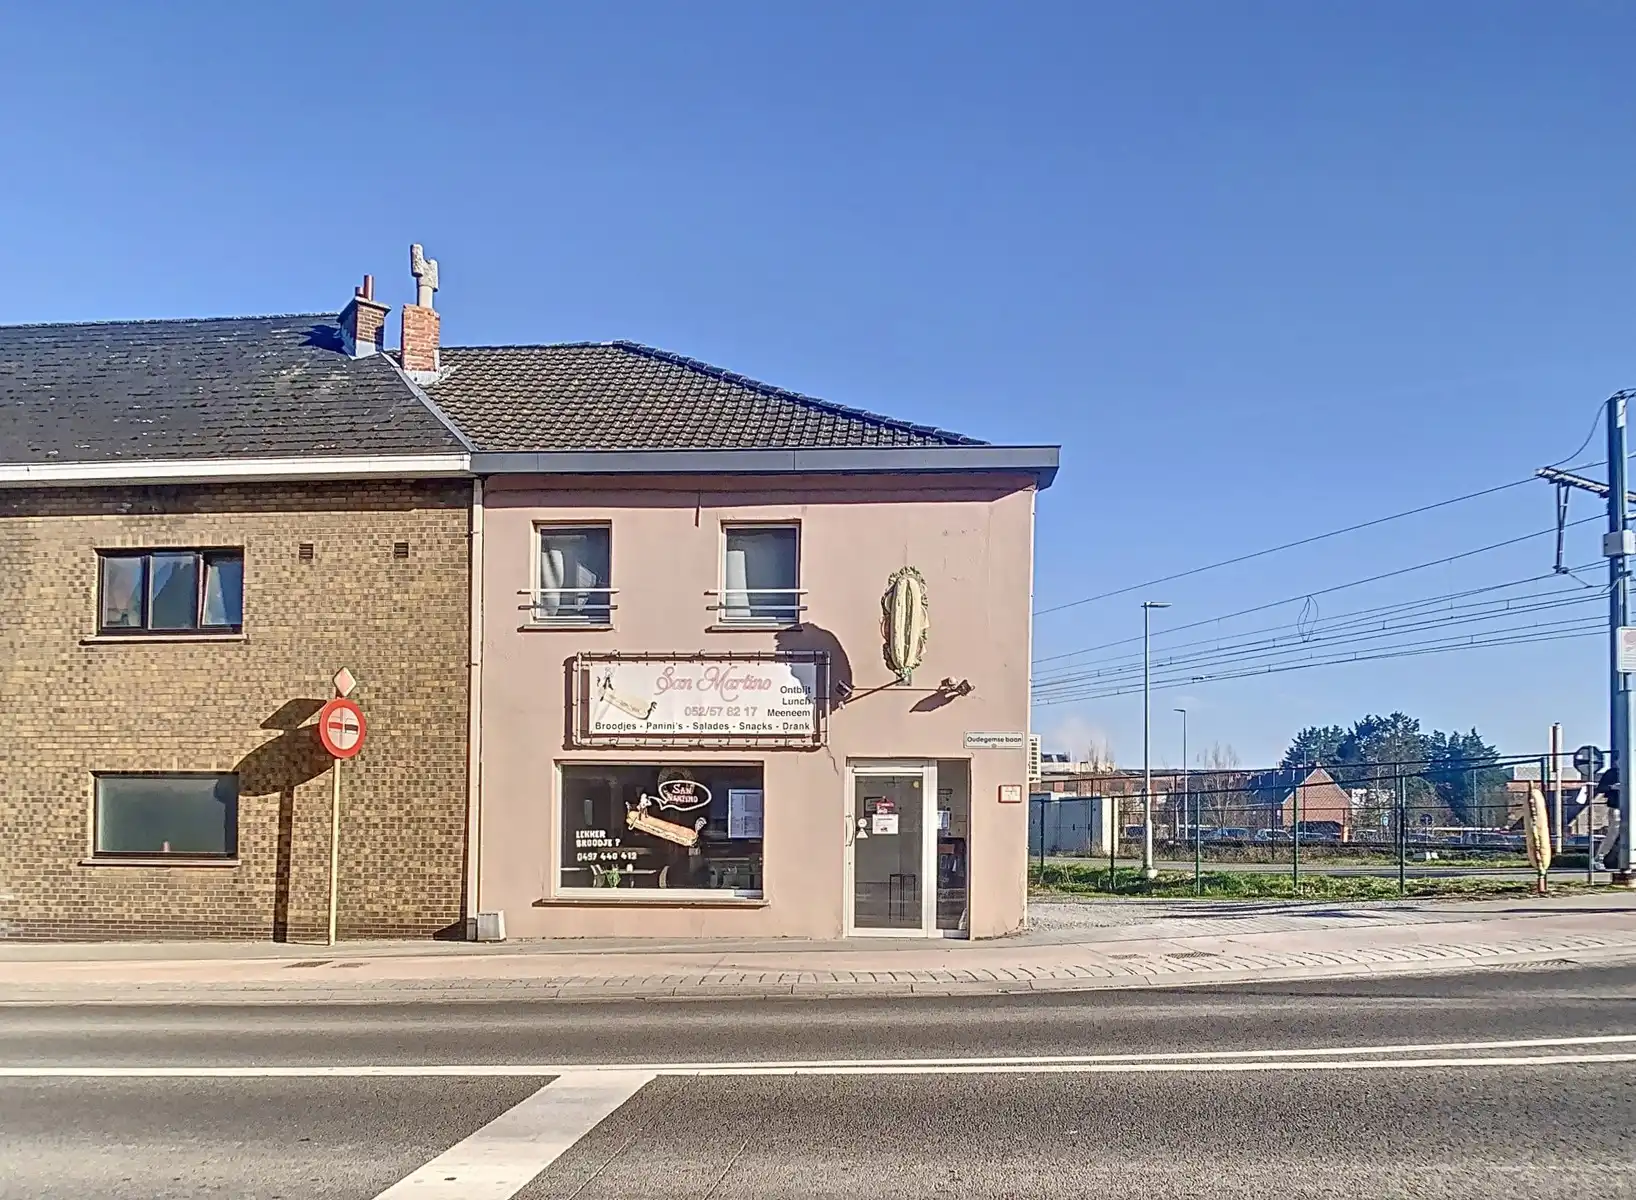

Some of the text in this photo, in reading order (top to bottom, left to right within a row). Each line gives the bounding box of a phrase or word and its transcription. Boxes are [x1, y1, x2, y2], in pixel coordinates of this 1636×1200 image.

[654, 666, 772, 702] San Martino
[782, 697, 811, 705] Lunch
[684, 706, 723, 717] 052/57
[744, 706, 758, 717] 17
[767, 708, 811, 717] Meeneem
[595, 721, 637, 732] Broodjes
[646, 721, 684, 731] Panini's
[692, 721, 730, 731] Salades
[739, 721, 773, 731] Snacks
[782, 721, 810, 731] Drank
[575, 830, 606, 838] LEKKER
[575, 839, 613, 848] BROODJE
[576, 851, 637, 862] 0497 440 412
